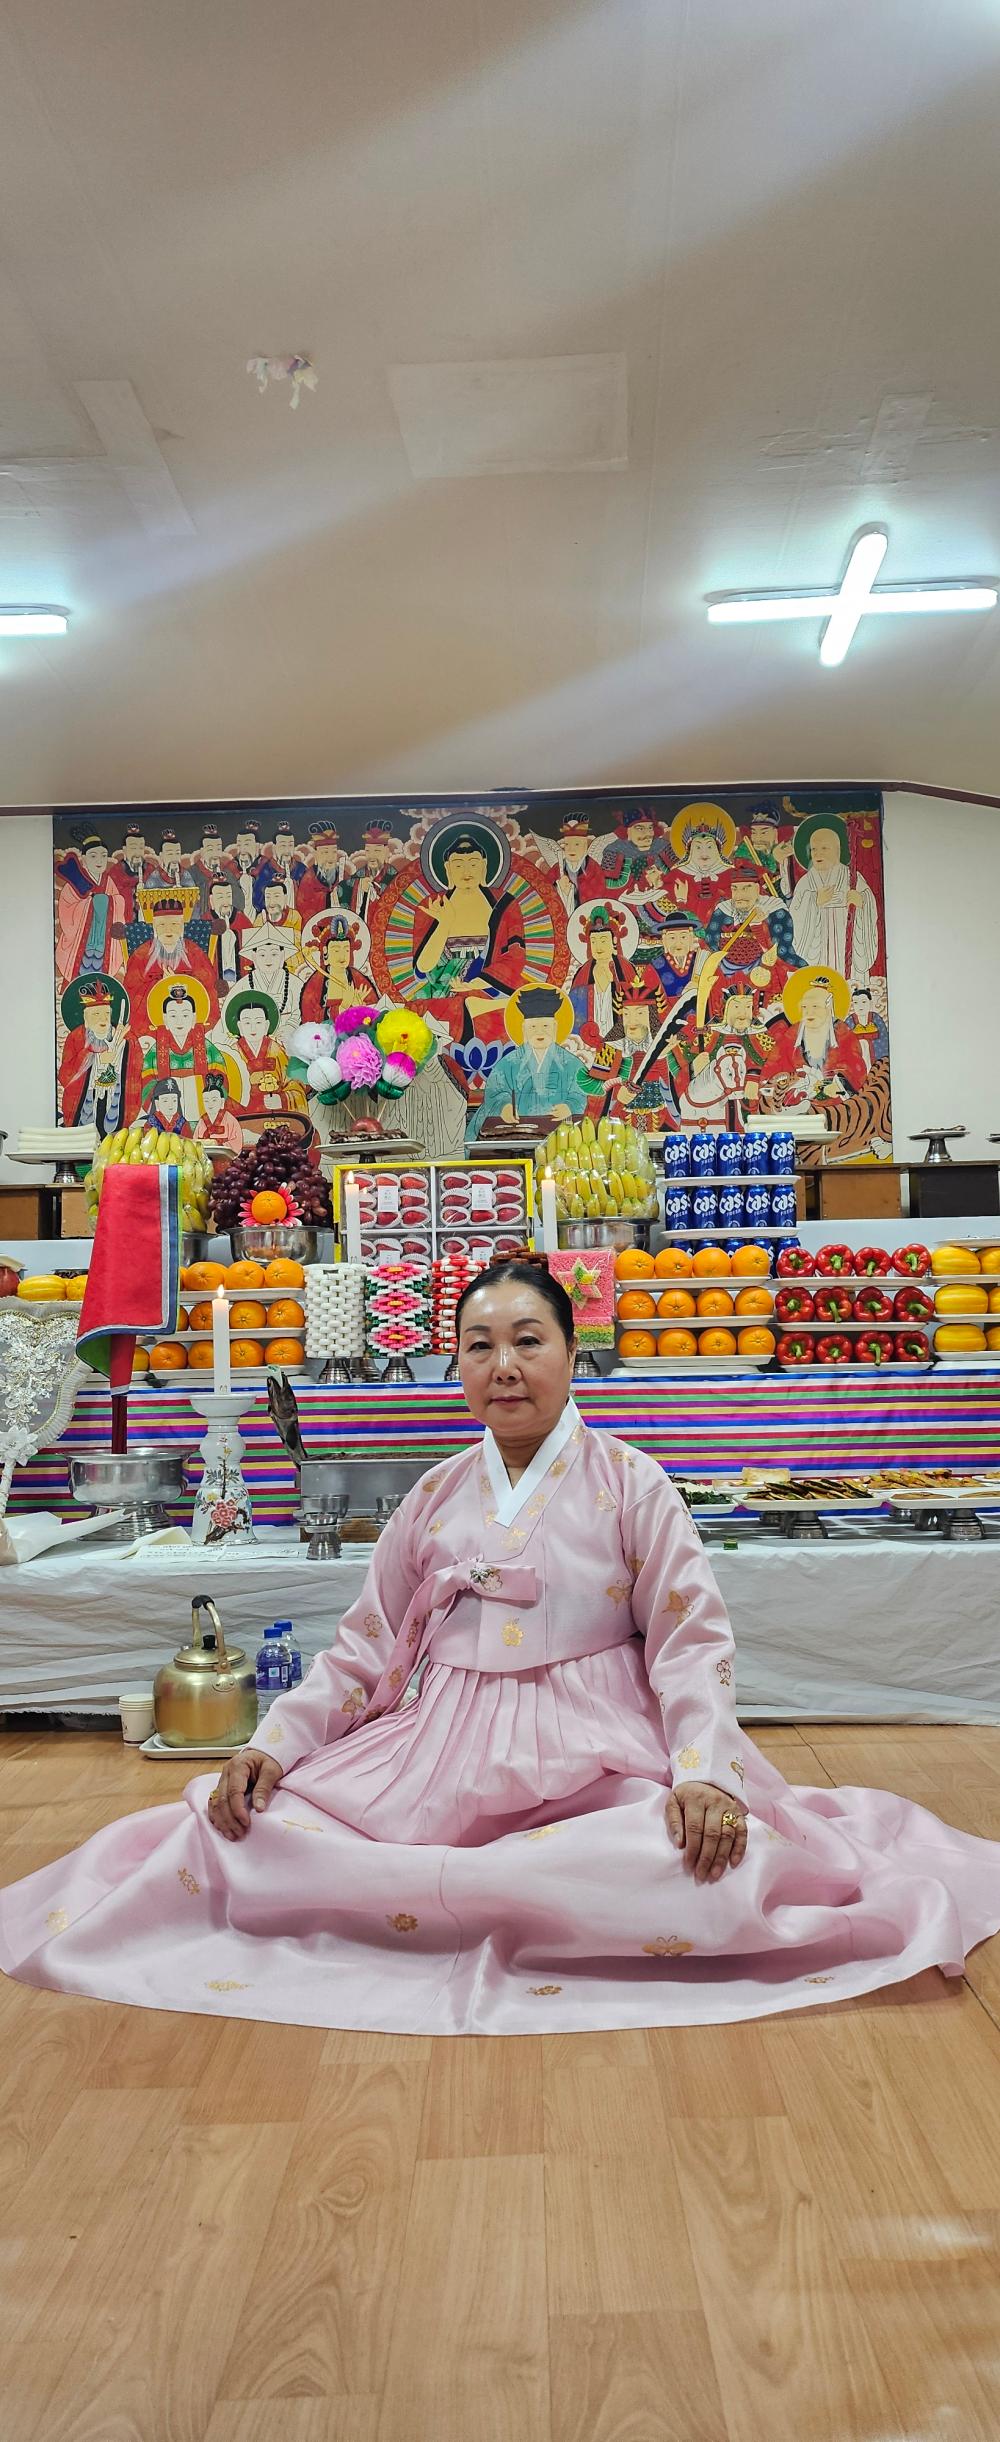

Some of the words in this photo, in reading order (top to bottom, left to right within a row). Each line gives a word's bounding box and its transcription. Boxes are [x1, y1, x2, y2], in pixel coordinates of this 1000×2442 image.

[693, 1141, 716, 1162] Cas
[720, 1140, 743, 1161] Cas
[743, 1137, 768, 1160] ass
[771, 1139, 795, 1160] Cas
[772, 1192, 796, 1213] Cas
